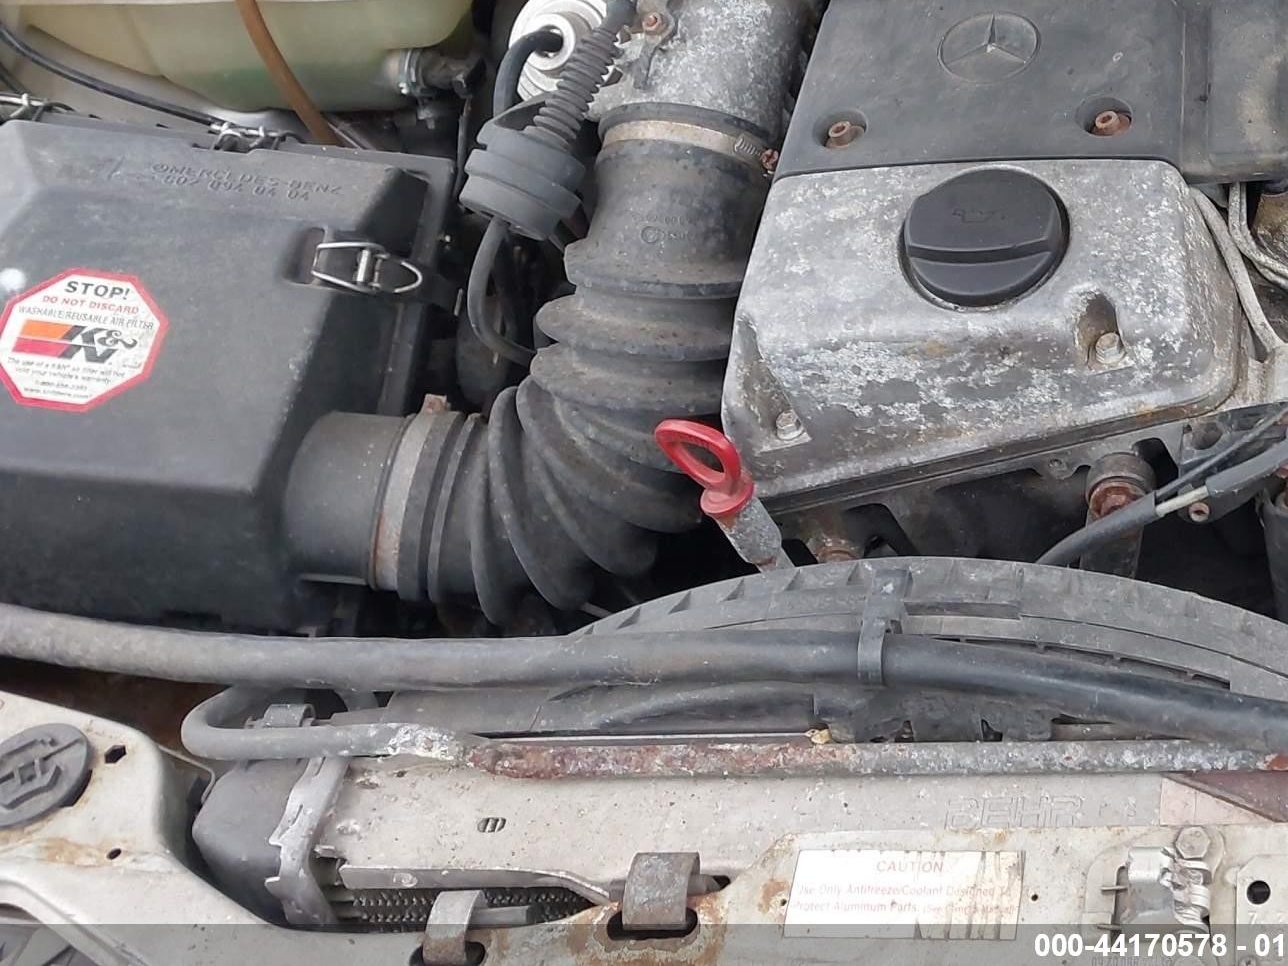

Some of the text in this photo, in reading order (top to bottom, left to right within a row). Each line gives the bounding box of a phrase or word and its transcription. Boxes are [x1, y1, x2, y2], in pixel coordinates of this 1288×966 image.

[64, 280, 131, 300] STOP!
[42, 295, 140, 315] DO NOT DISCARD
[876, 860, 945, 874] CAUTION
[818, 885, 843, 898] Only
[834, 900, 887, 912] Aluminum
